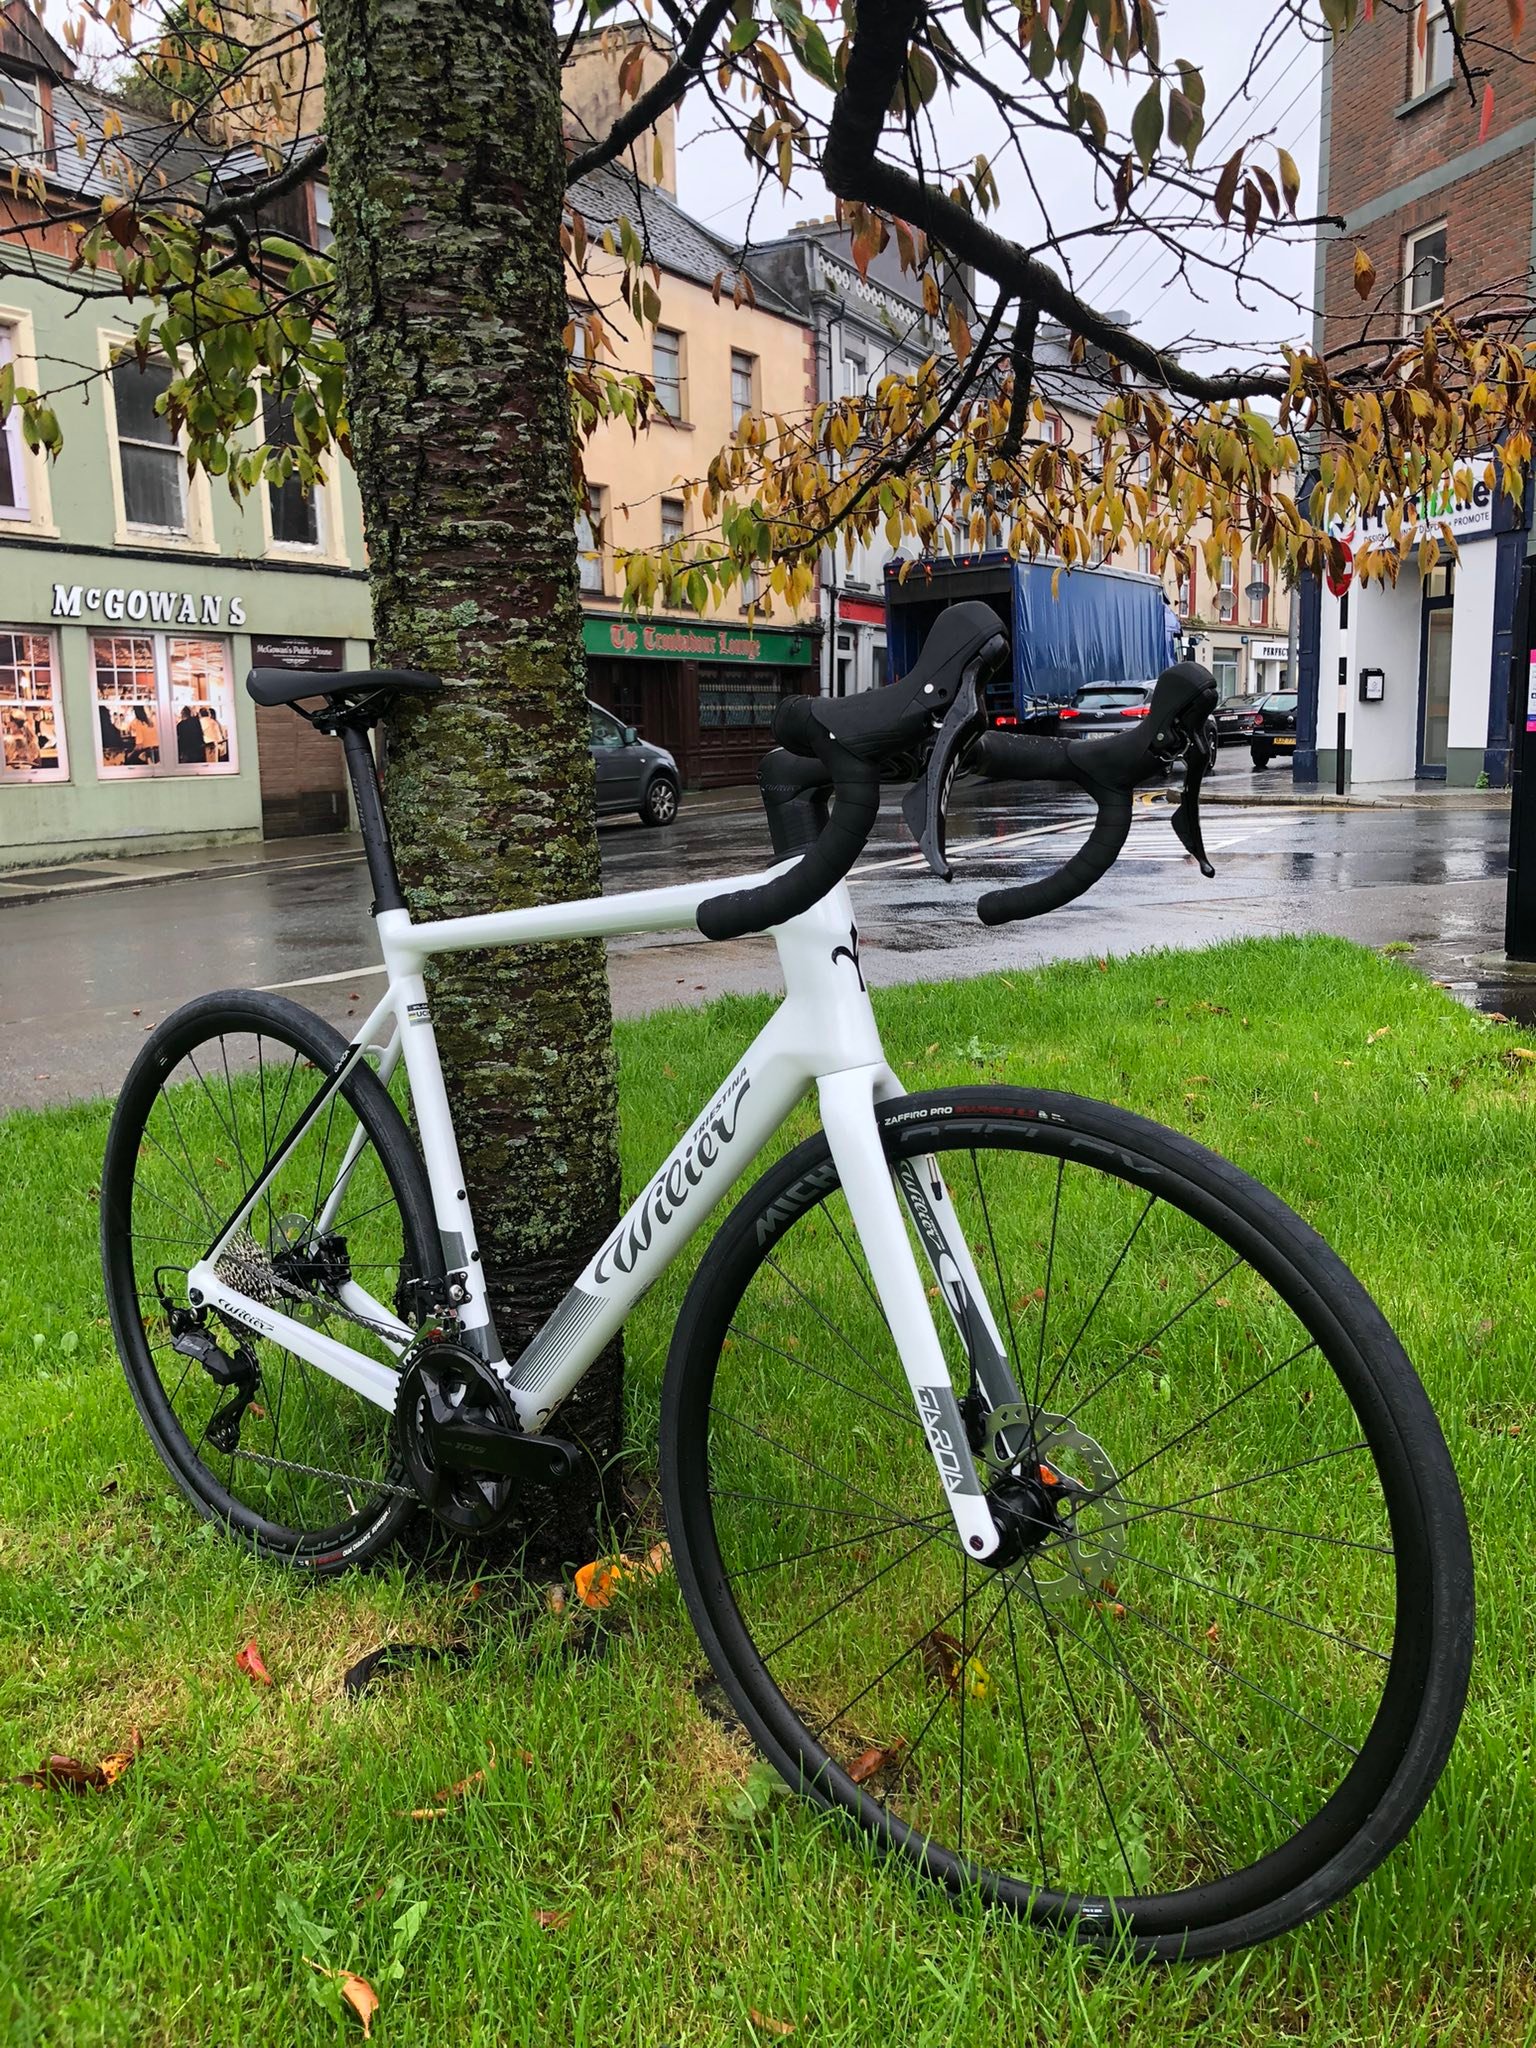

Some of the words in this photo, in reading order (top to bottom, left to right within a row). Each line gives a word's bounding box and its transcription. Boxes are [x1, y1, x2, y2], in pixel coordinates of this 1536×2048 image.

[1453, 513, 1489, 527] PROMOTE
[256, 644, 293, 654] McGowan's
[293, 645, 312, 655] Public
[312, 646, 333, 656] House
[610, 623, 639, 653] The
[718, 631, 761, 660] Lounge
[692, 1066, 748, 1143] TRIESTINA
[884, 1109, 928, 1126] ZAFFIRO
[930, 1106, 953, 1116] PRO
[594, 1077, 751, 1285] Wilier
[756, 1164, 838, 1247] MICH
[218, 1298, 273, 1332] Wilier
[917, 1385, 964, 1494] GARDA
